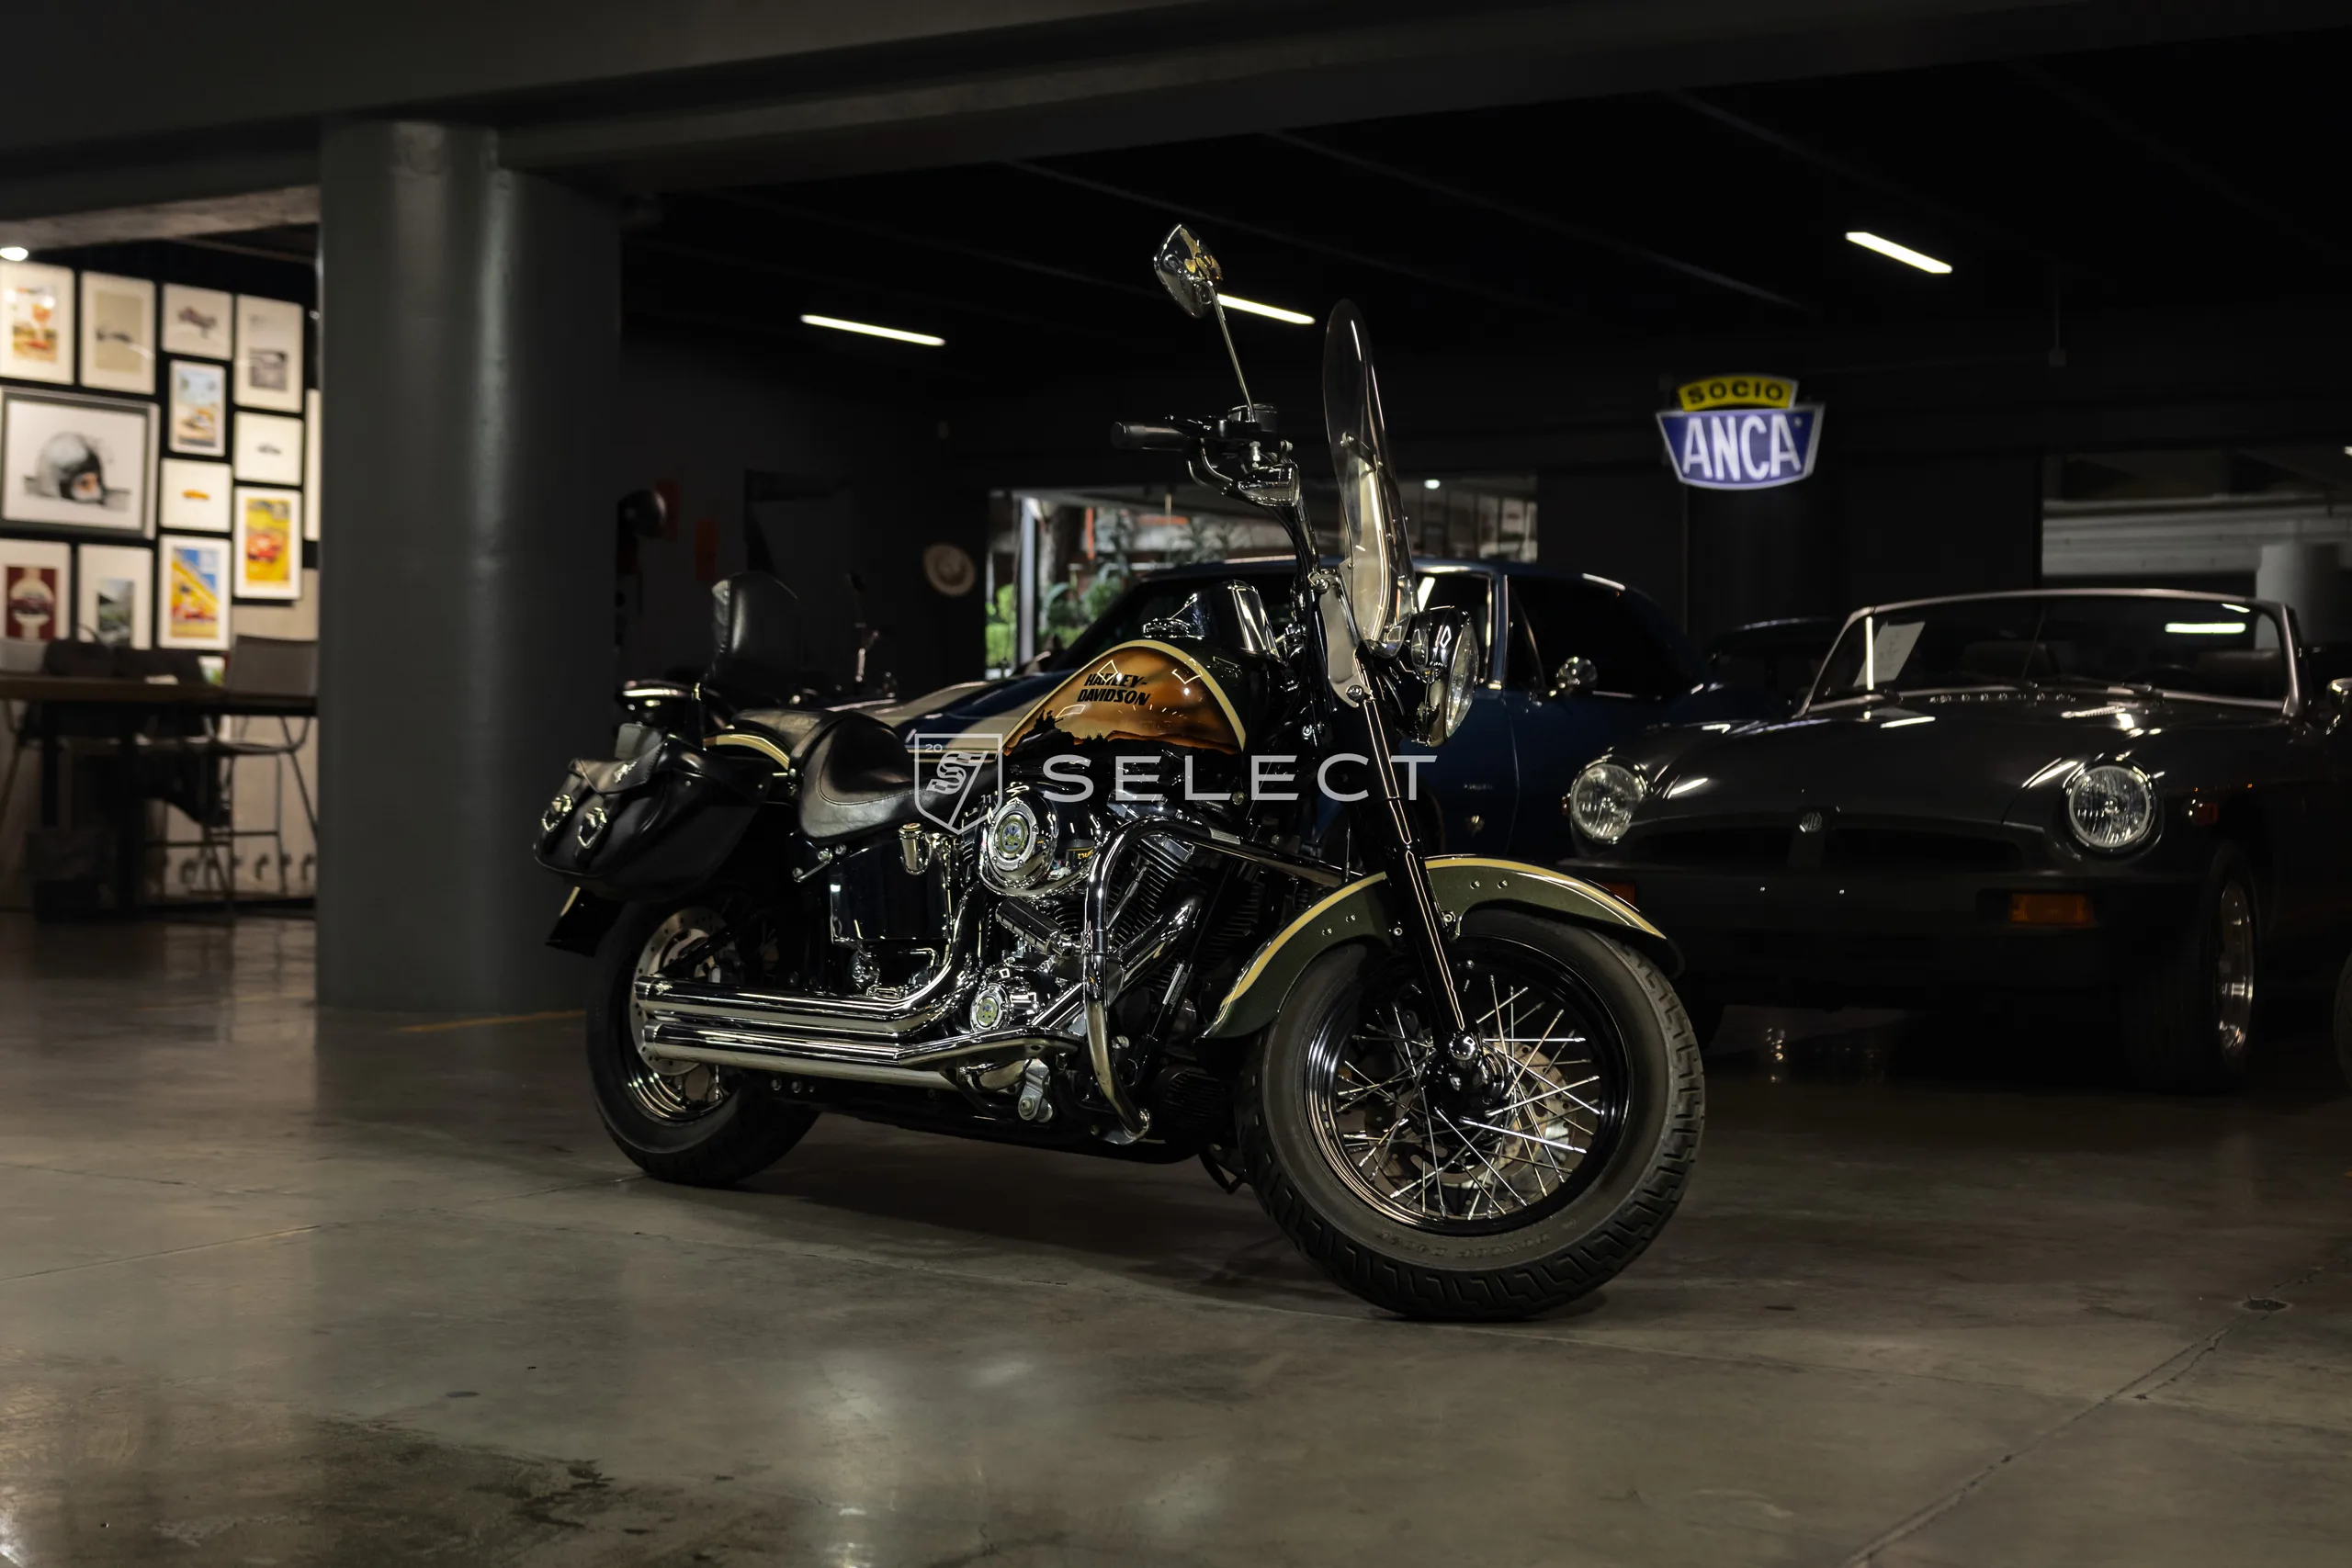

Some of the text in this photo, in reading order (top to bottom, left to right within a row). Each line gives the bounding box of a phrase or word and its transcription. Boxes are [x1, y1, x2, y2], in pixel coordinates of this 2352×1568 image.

[1687, 380, 1783, 403] SOCIO
[1682, 414, 1802, 481] ANCA
[1077, 689, 1151, 705] DAVIDSON
